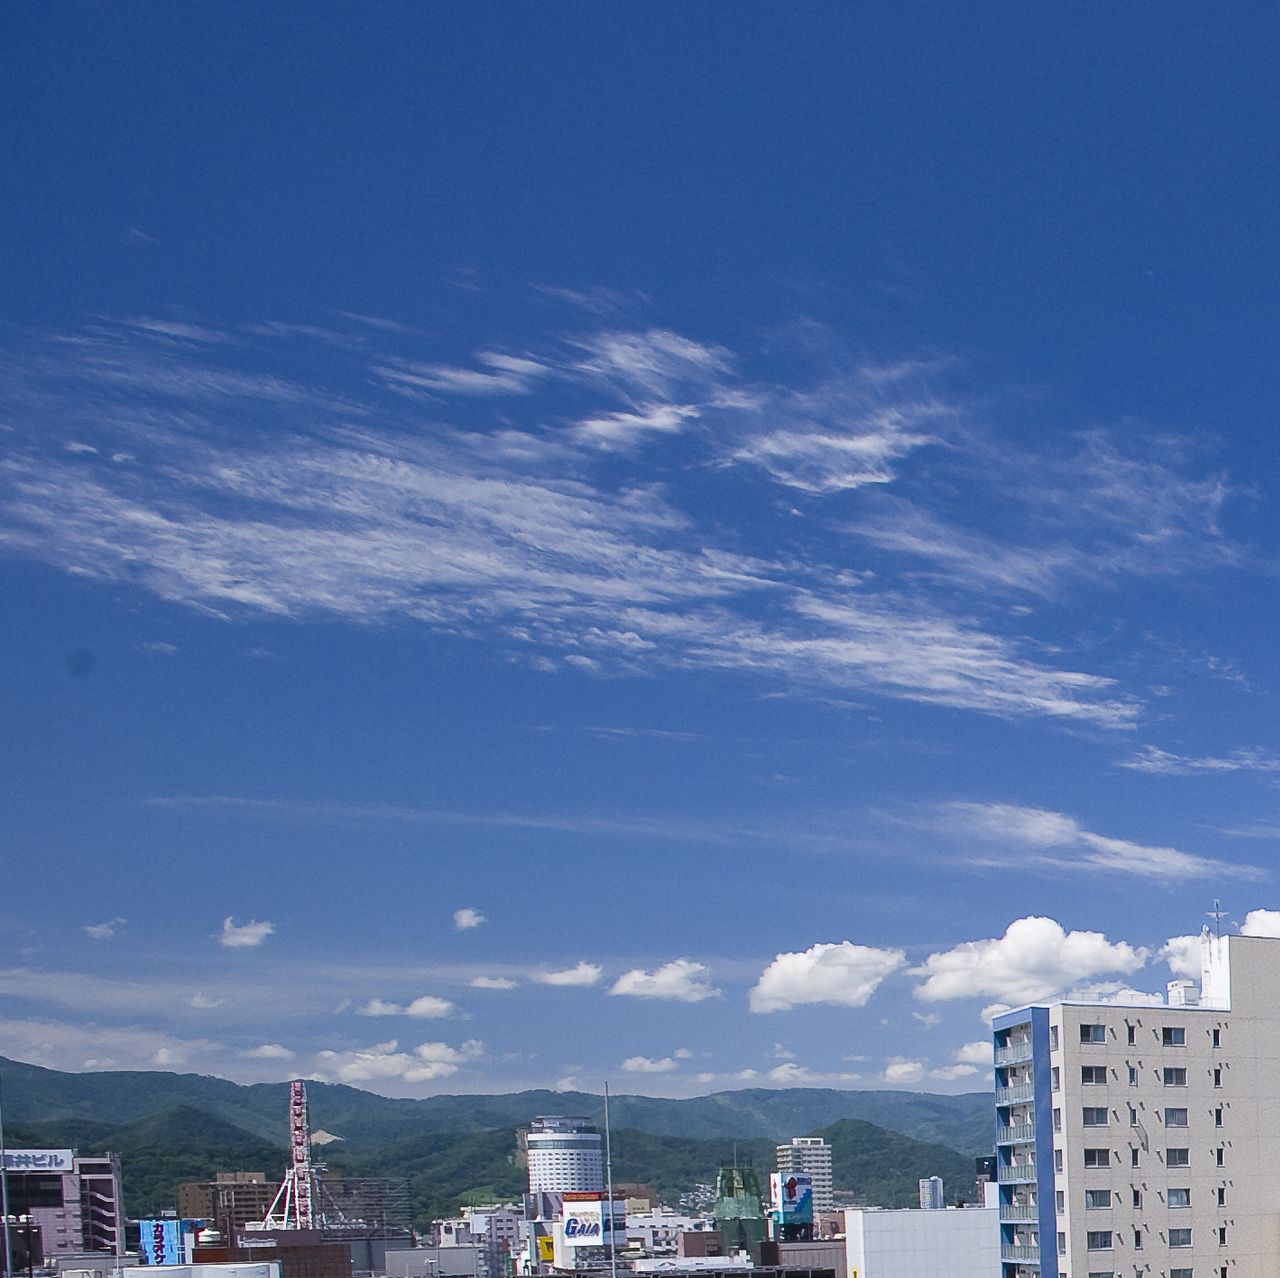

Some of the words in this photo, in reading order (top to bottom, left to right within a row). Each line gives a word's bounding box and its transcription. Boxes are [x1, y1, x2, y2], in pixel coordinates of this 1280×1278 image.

[152, 1222, 166, 1264] カラオケ
[565, 1218, 601, 1238] GAIA
